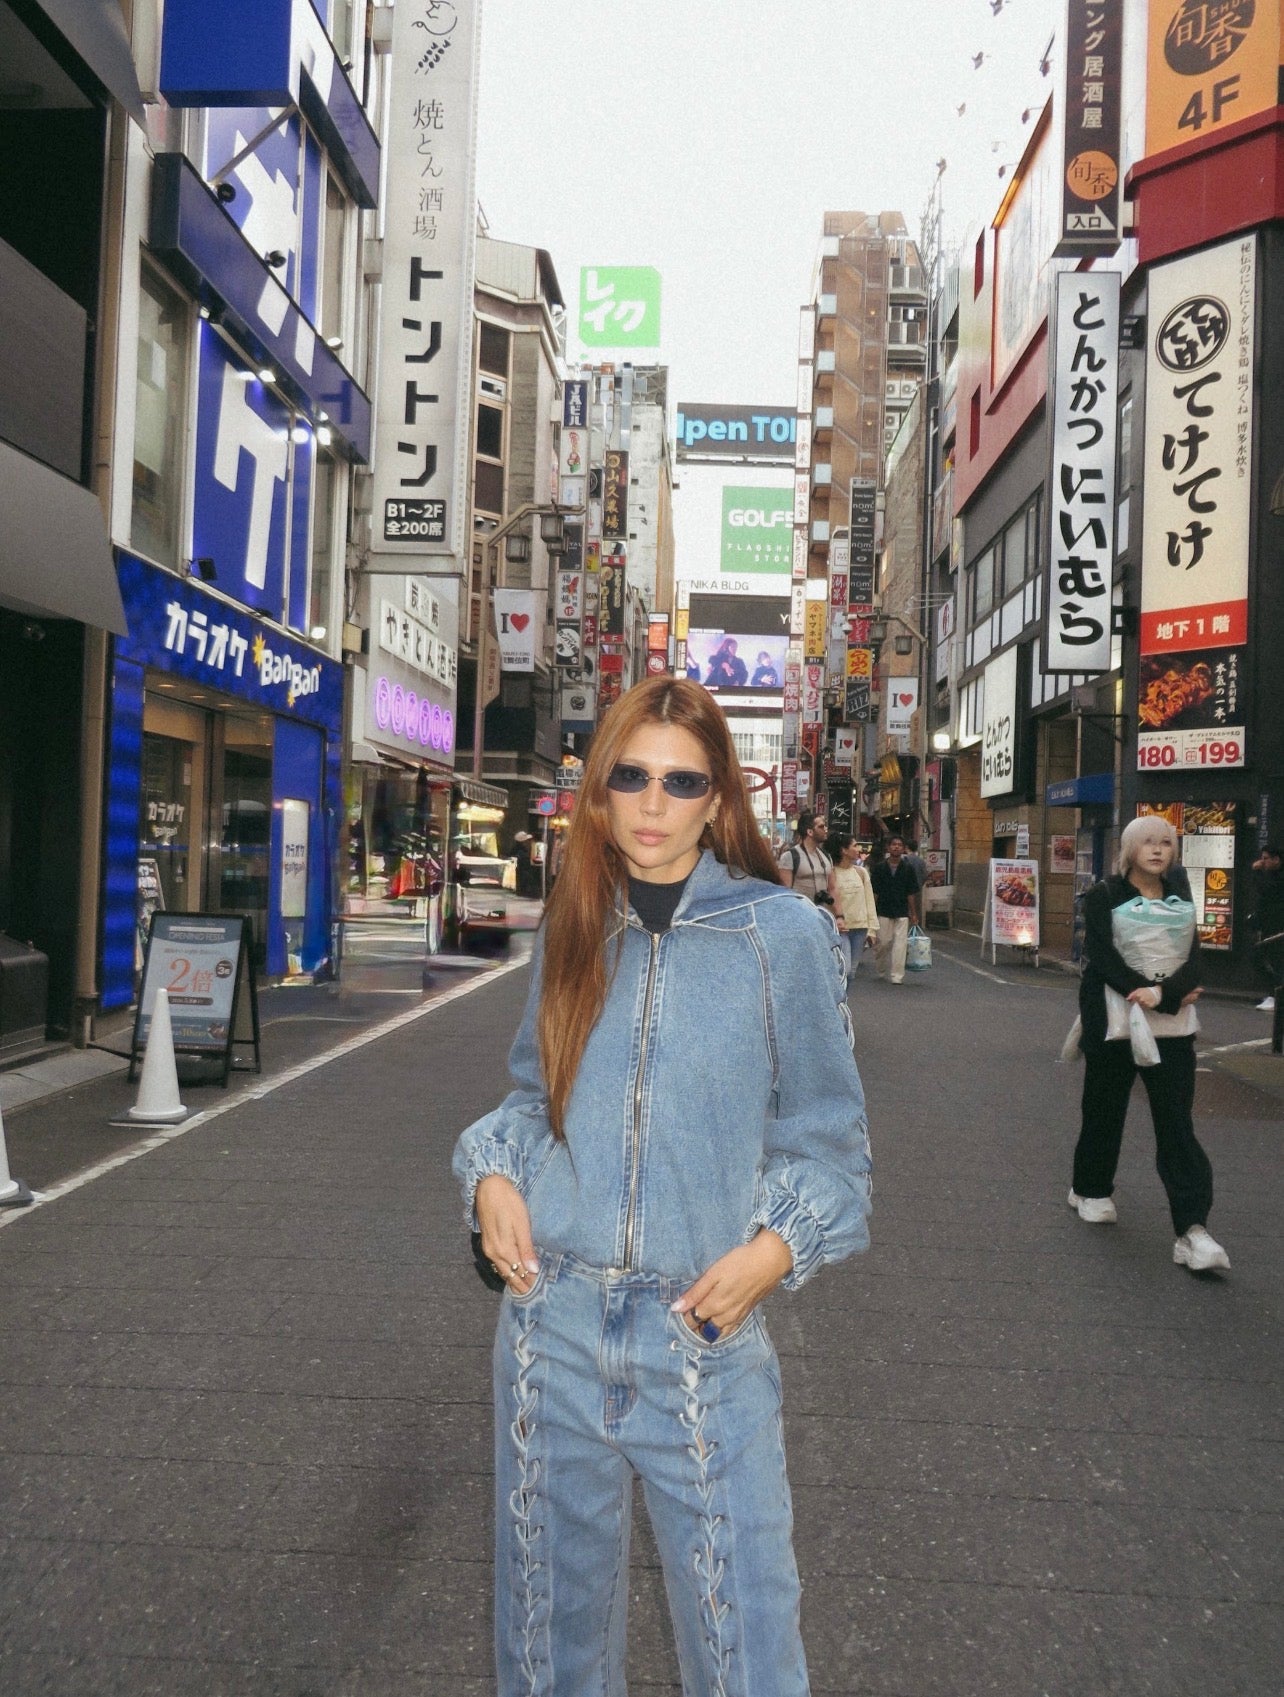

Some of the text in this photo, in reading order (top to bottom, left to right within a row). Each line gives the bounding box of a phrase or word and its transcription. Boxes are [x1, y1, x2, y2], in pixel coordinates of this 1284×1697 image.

[1168, 4, 1247, 61] 旬香
[1081, 0, 1105, 128] ング居酒屋
[1178, 74, 1241, 130] 4F
[412, 99, 445, 240] 焼とん 酒場
[1070, 158, 1114, 194] 旬香
[1072, 215, 1102, 229] 入口
[584, 270, 647, 333] レイク
[398, 257, 443, 487] トントン
[1058, 291, 1108, 647] とんかつ にいむら
[1161, 371, 1222, 571] てけてけ
[386, 520, 443, 537] 全200席
[721, 581, 749, 592] BLDG
[164, 600, 249, 679] カラオケ
[501, 612, 510, 634] I
[1156, 615, 1230, 640] 地下1階
[260, 648, 322, 699] BanBan
[892, 693, 898, 708] I
[838, 738, 843, 750] I
[986, 715, 1011, 749] とんかつ
[983, 746, 1013, 782] にいむら
[1140, 744, 1176, 768] 180
[1198, 740, 1240, 764] 199
[1197, 824, 1231, 834] Yakitori
[167, 958, 214, 993] 2倍
